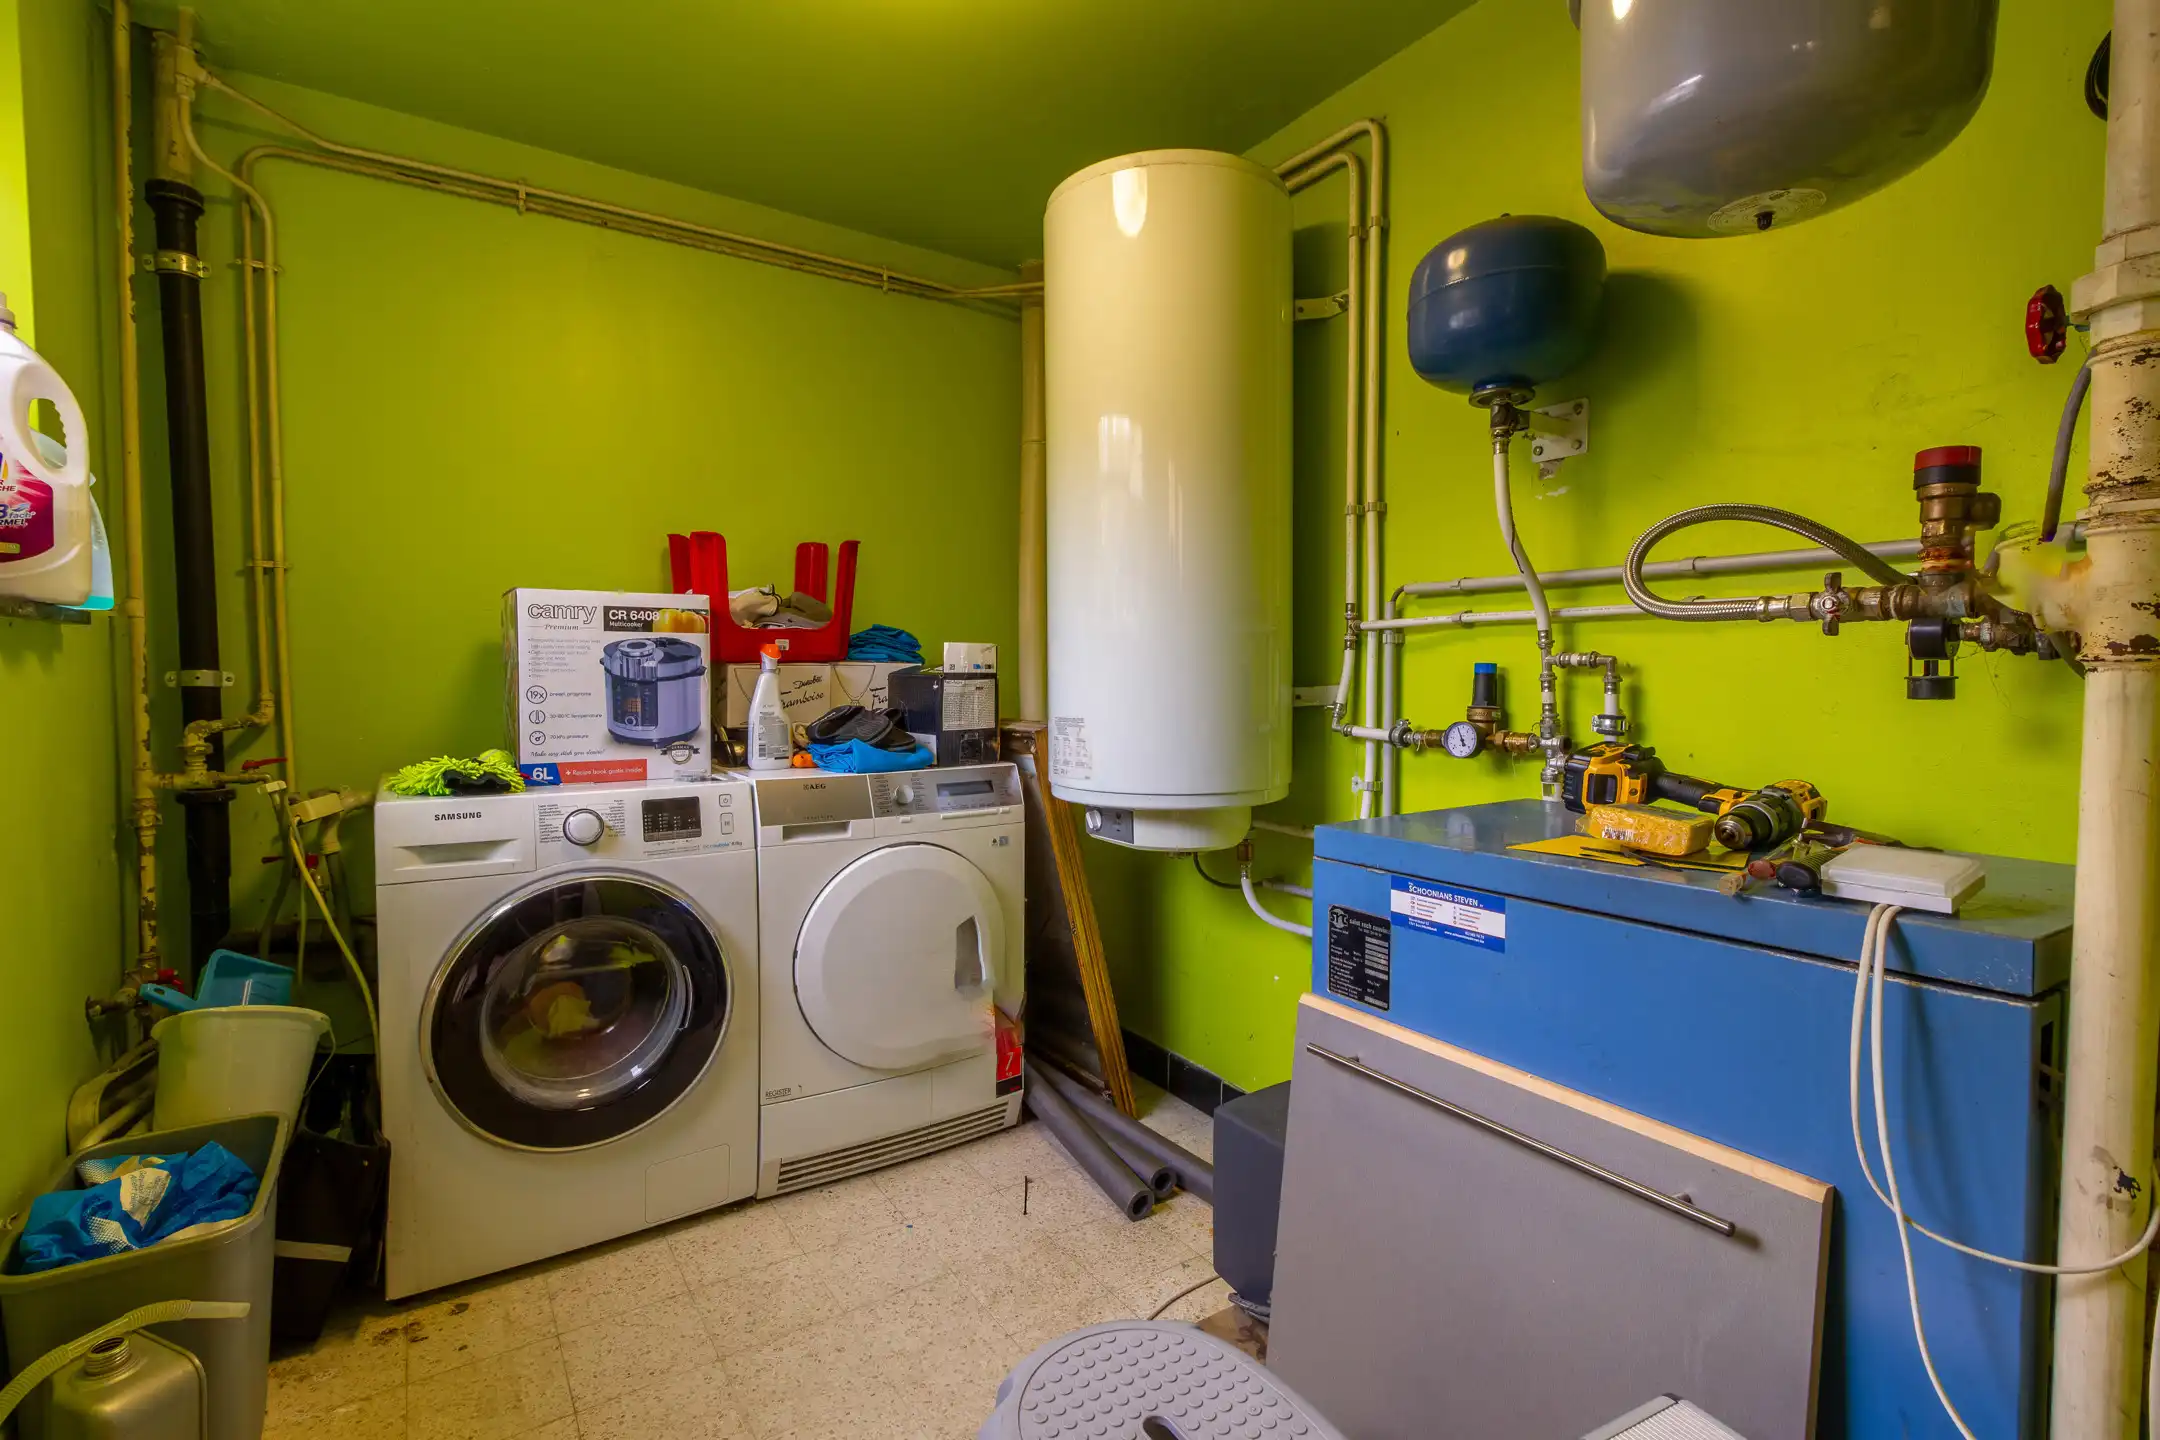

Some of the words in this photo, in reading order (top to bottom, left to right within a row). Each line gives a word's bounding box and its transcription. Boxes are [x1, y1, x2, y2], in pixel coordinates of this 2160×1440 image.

[527, 603, 598, 625] camry
[608, 609, 627, 621] CR
[629, 610, 660, 621] 6408
[544, 623, 579, 631] Premium
[609, 620, 644, 628] Multicooker
[780, 690, 825, 710] ramboise
[532, 767, 554, 781] 6L
[809, 783, 827, 791] AEG
[434, 811, 482, 821] SAMSUNG
[1408, 884, 1453, 901] SCHOONIANS
[1453, 894, 1478, 907] STEVEN
[765, 1087, 792, 1098] REGISTER
